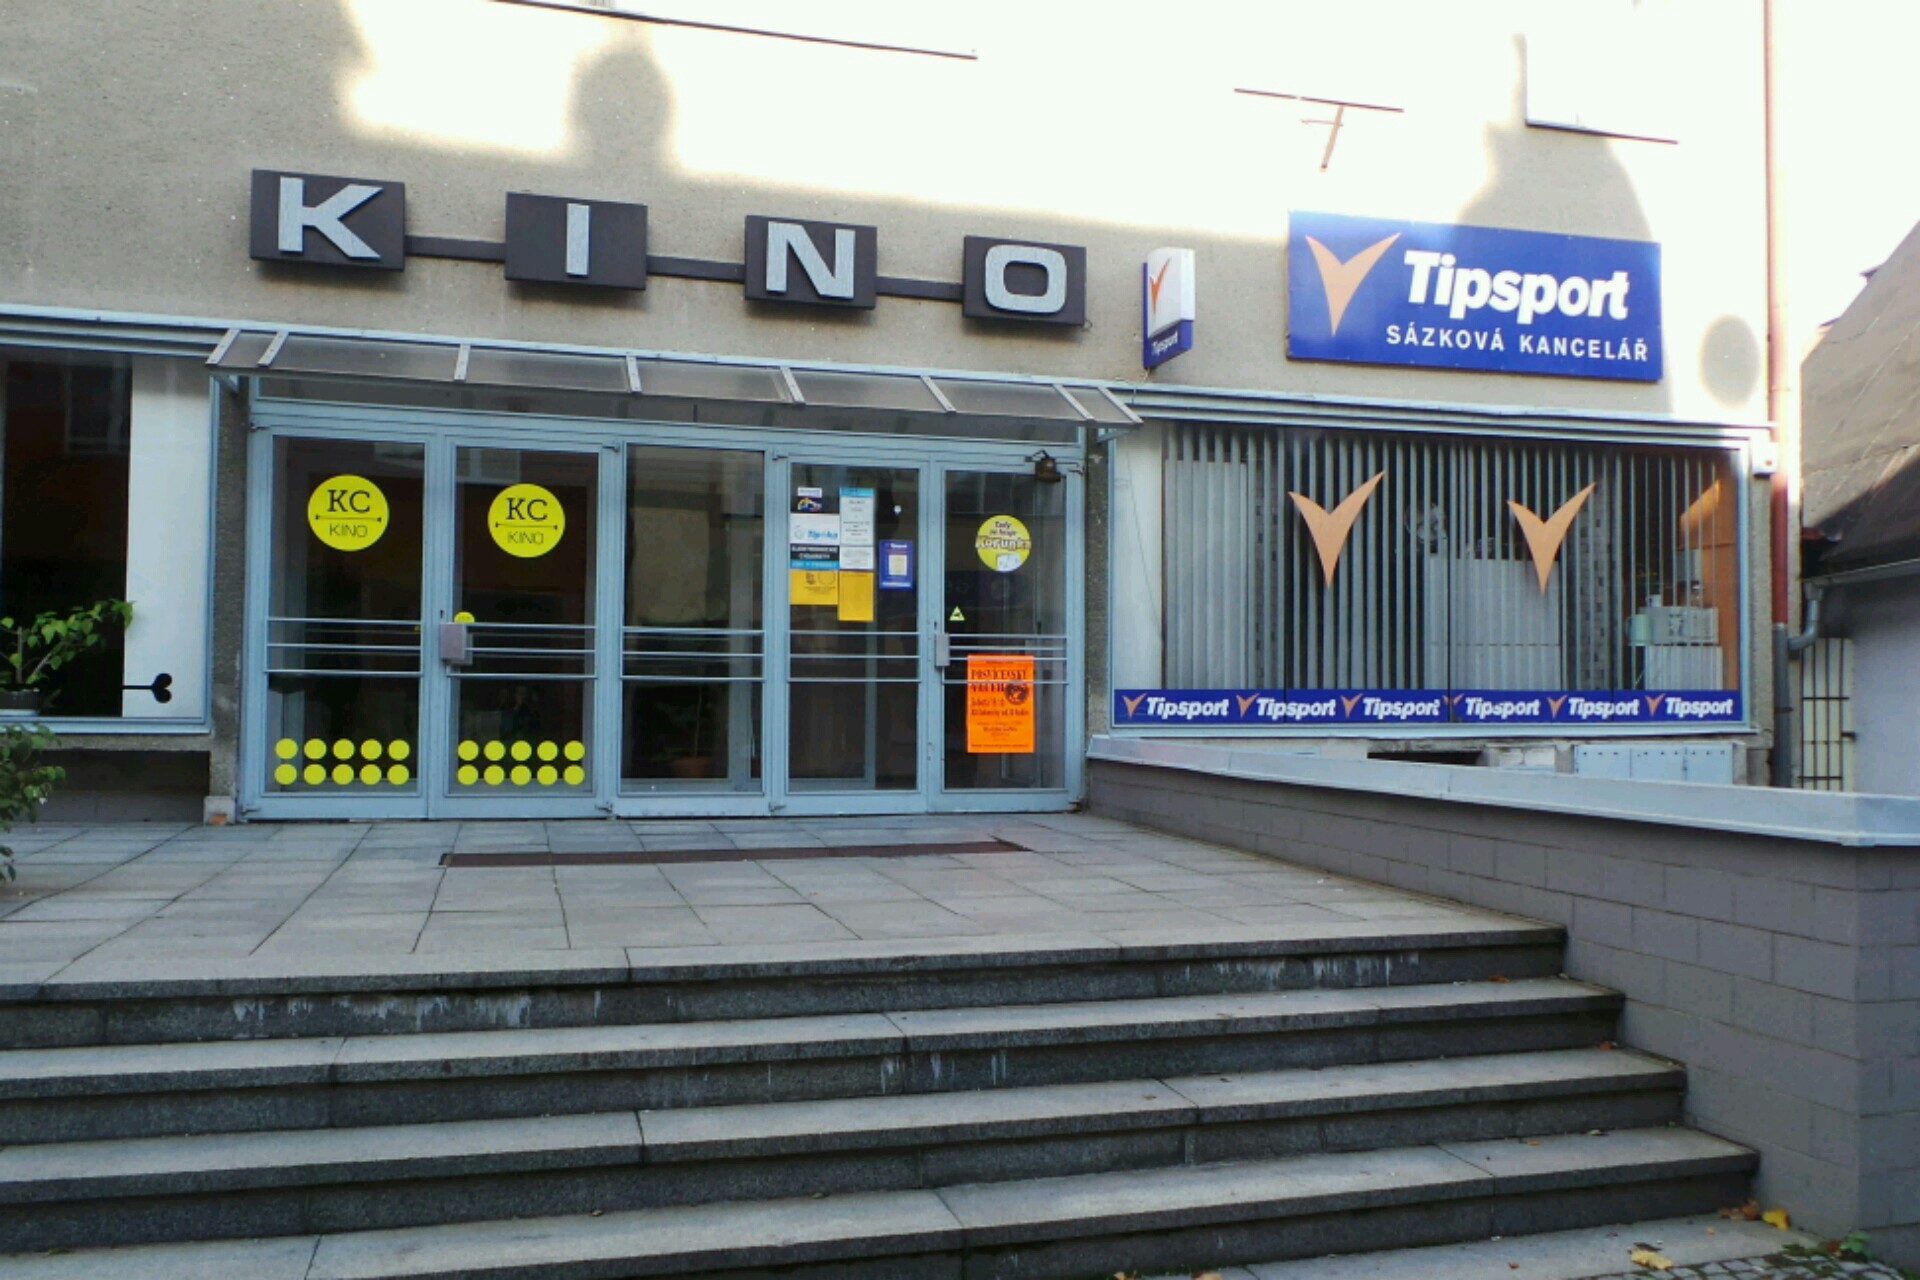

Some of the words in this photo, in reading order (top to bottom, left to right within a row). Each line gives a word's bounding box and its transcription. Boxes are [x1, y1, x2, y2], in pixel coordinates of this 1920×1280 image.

[278, 176, 1067, 313] KINO
[1404, 249, 1629, 324] Tipsport
[1386, 321, 1505, 351] SÁZKOVÁ
[1519, 334, 1649, 361] KANCELÁŘ
[327, 489, 371, 513] KC
[506, 497, 549, 521] KC
[328, 523, 368, 538] KINO
[507, 531, 545, 546] KINO
[1146, 696, 1229, 720] Tipsport
[1256, 697, 1336, 720] Tipsport
[1362, 697, 1440, 720] Tipsport
[1465, 697, 1540, 719] Tipsport
[1568, 697, 1639, 719] Tipsport
[1665, 697, 1734, 718] Tipsport
